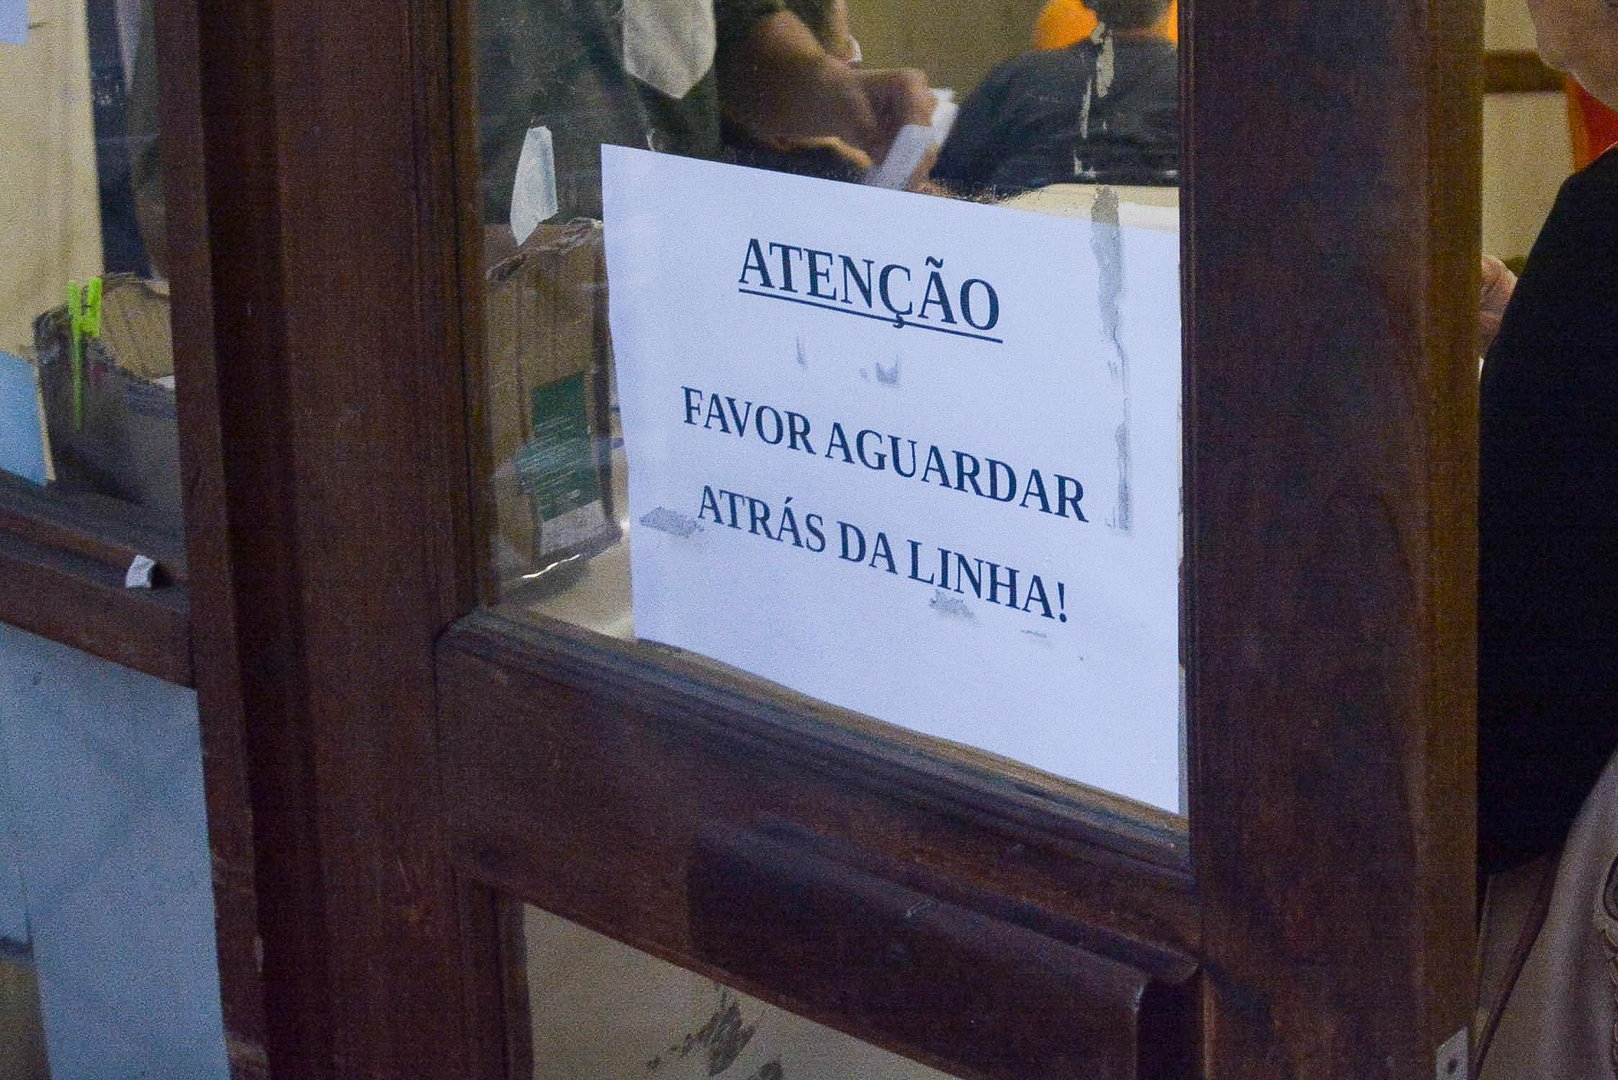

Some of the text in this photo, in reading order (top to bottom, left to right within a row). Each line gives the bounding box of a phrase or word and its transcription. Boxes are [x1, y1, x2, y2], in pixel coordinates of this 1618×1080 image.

[738, 238, 1000, 331] ATENÇÃO
[681, 386, 1089, 523] FAVOR AGUARDAR
[698, 485, 1067, 623] ATRÁS DA LINHA!
